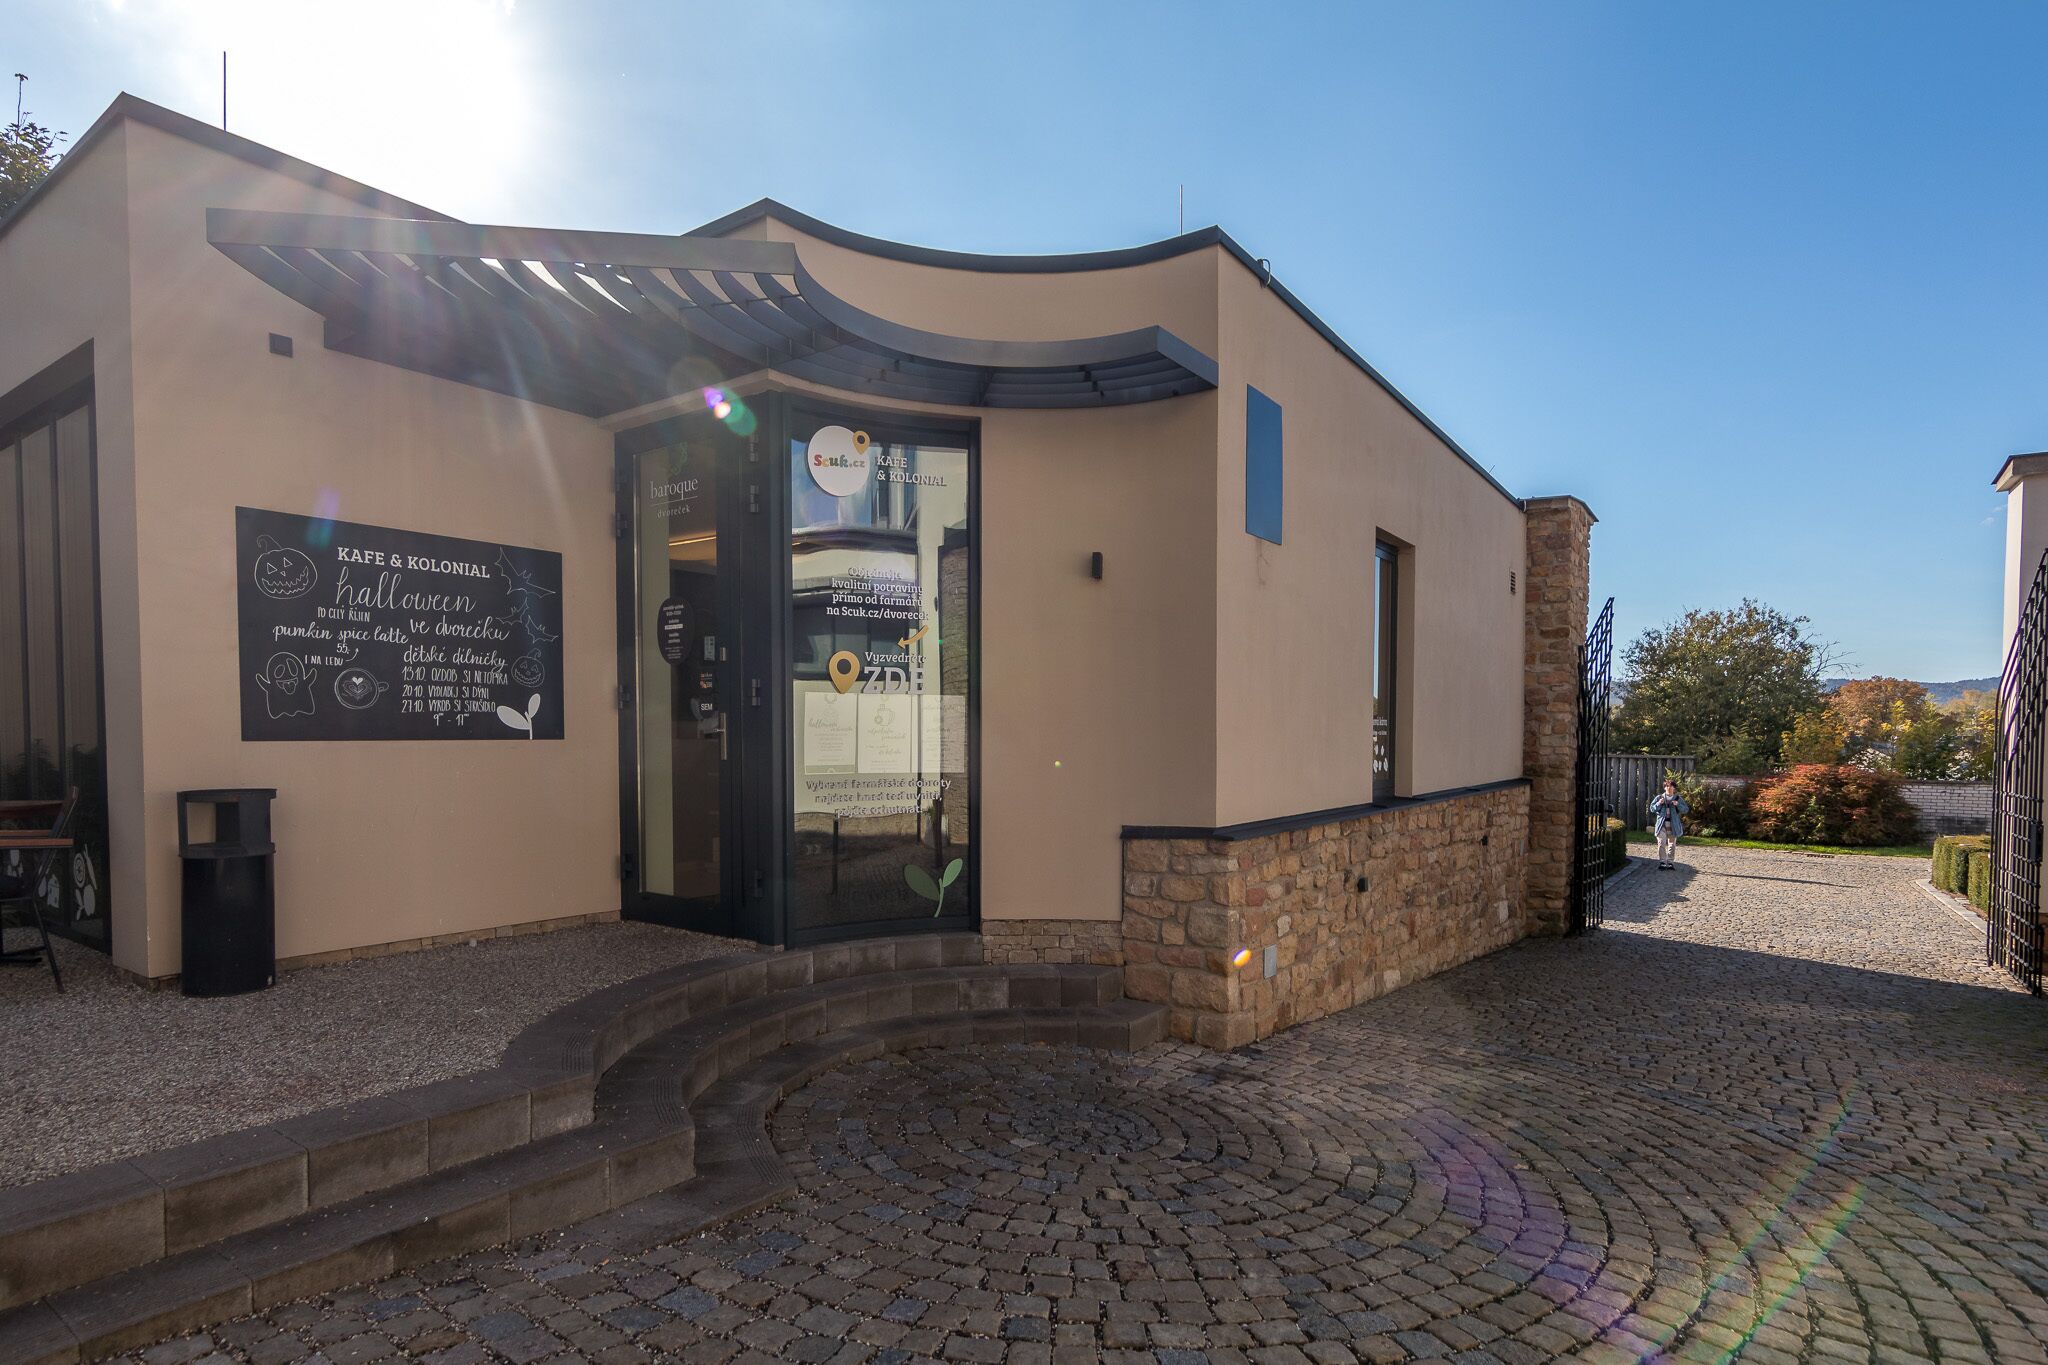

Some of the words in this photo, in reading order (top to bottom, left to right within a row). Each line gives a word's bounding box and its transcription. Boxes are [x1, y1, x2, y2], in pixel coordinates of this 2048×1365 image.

[814, 454, 866, 468] Scuk.cz
[876, 455, 908, 468] KAFE
[876, 470, 886, 481] &
[889, 472, 947, 487] KOLONIAL
[649, 478, 698, 500] baroque
[337, 546, 385, 566] KAFE
[390, 553, 402, 568] &
[407, 555, 490, 578] KOLONIAL
[336, 566, 477, 613] halloween
[832, 578, 871, 591] kvalitní
[873, 583, 924, 596] potraviny
[832, 592, 863, 604] přímo
[865, 594, 878, 604] od
[879, 594, 924, 607] farmářů
[317, 606, 327, 618] PO
[826, 606, 840, 615] na
[841, 606, 929, 620] Scuk.cz/dvorecek
[272, 621, 333, 642] pumkin
[337, 627, 371, 643] spice
[373, 625, 409, 644] latte
[410, 618, 430, 634] ve
[435, 614, 510, 640] dvorečku
[310, 655, 322, 665] NA
[325, 656, 344, 666] LEDU
[403, 645, 447, 665] dětské
[452, 647, 508, 674] dílničky
[431, 667, 458, 682] OZDOB
[462, 669, 471, 684] SI
[861, 666, 926, 694] ZDE
[462, 686, 470, 698] SI
[472, 685, 490, 699] DÝNI
[428, 700, 451, 712] VYROB
[453, 700, 461, 712] SI
[464, 699, 496, 713] STRAŠIDLO
